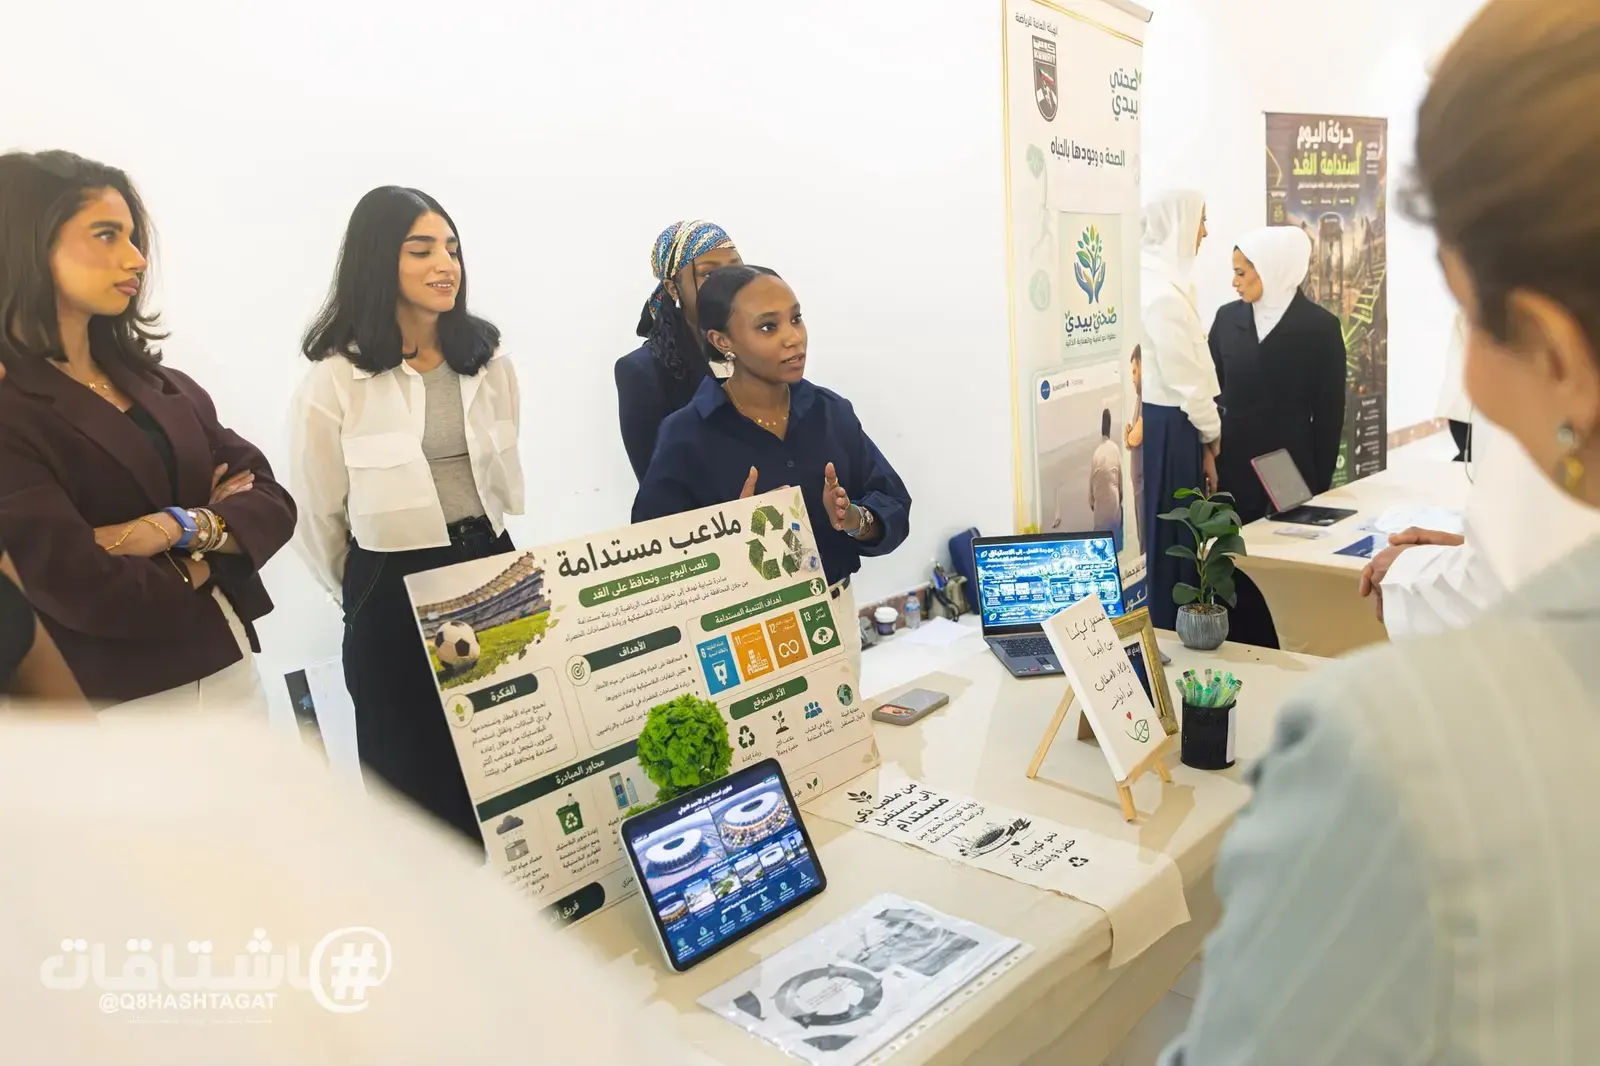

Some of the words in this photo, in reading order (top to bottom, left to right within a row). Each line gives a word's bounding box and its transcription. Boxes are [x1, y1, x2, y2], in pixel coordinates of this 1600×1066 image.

[1110, 68, 1138, 94] صحتي
[1112, 95, 1138, 121] بيدي
[1297, 121, 1326, 150] اليوم
[1327, 120, 1354, 150] حركة
[1050, 136, 1070, 163] بالحياه
[1071, 141, 1099, 167] وجودها
[1105, 147, 1125, 167] الصحة
[1292, 151, 1318, 176] الغد
[1065, 311, 1092, 337] بيدي
[669, 511, 742, 555] ملاعب
[557, 539, 662, 578] مستدامة
[689, 558, 708, 574] نلعب
[611, 582, 628, 597] على
[630, 575, 660, 591] ونحافظ
[592, 586, 610, 601] الغد
[661, 591, 677, 603] تحويل
[710, 584, 731, 597] المحافظة
[641, 594, 660, 608] الملاعب
[673, 597, 689, 610] وتقليل
[689, 592, 702, 603] المياه
[766, 594, 782, 607] أهداف
[620, 600, 641, 615] الرياضية
[627, 606, 654, 622] البلاستيكية
[654, 602, 672, 614] النفايات
[745, 601, 765, 614] التنمية
[577, 614, 601, 625] مستدامة
[611, 616, 627, 628] وزيادة
[715, 608, 745, 624] المستدامة
[803, 612, 812, 622] 13
[586, 620, 612, 635] المساحات
[768, 623, 777, 634] 12
[565, 630, 586, 643] الخضراء
[735, 636, 742, 646] 11
[618, 641, 647, 657] الأهداف
[700, 648, 707, 659] 6
[666, 654, 683, 666] المحافظة
[637, 677, 660, 691] البلاستيكية
[660, 684, 680, 697] المساحات
[490, 684, 517, 702] الفكرة
[642, 691, 660, 703] الخضراء
[775, 688, 786, 700] الأثر
[617, 701, 636, 713] الملاعب
[753, 693, 775, 709] المتوقع
[502, 710, 519, 723] الأمطار
[520, 708, 531, 716] مياه
[545, 712, 552, 721] في
[536, 716, 545, 724] ري
[620, 716, 636, 727] الشباب
[521, 725, 547, 739] البلاستيك
[807, 731, 823, 742] الاستدامة
[497, 741, 510, 750] خلال
[511, 737, 520, 745] من
[481, 744, 495, 754] إعادة
[494, 748, 516, 762] الملاعب
[536, 744, 558, 757] استدامة
[483, 755, 493, 768] أكثر
[514, 755, 535, 767] ونحافظ
[585, 760, 606, 772] محاور
[501, 763, 513, 773] على
[556, 765, 585, 786] المبادرة
[901, 784, 918, 795] من
[919, 790, 937, 802] إلى
[873, 793, 902, 811] ملعب
[854, 808, 874, 824] ذكي
[875, 801, 918, 827] مستقبل
[896, 799, 949, 833] مستدام
[555, 837, 577, 851] البلاستيك
[518, 861, 528, 870] مياه
[562, 854, 585, 868] البلاستيكية
[530, 867, 542, 877] جمع
[562, 900, 580, 919] فريق
